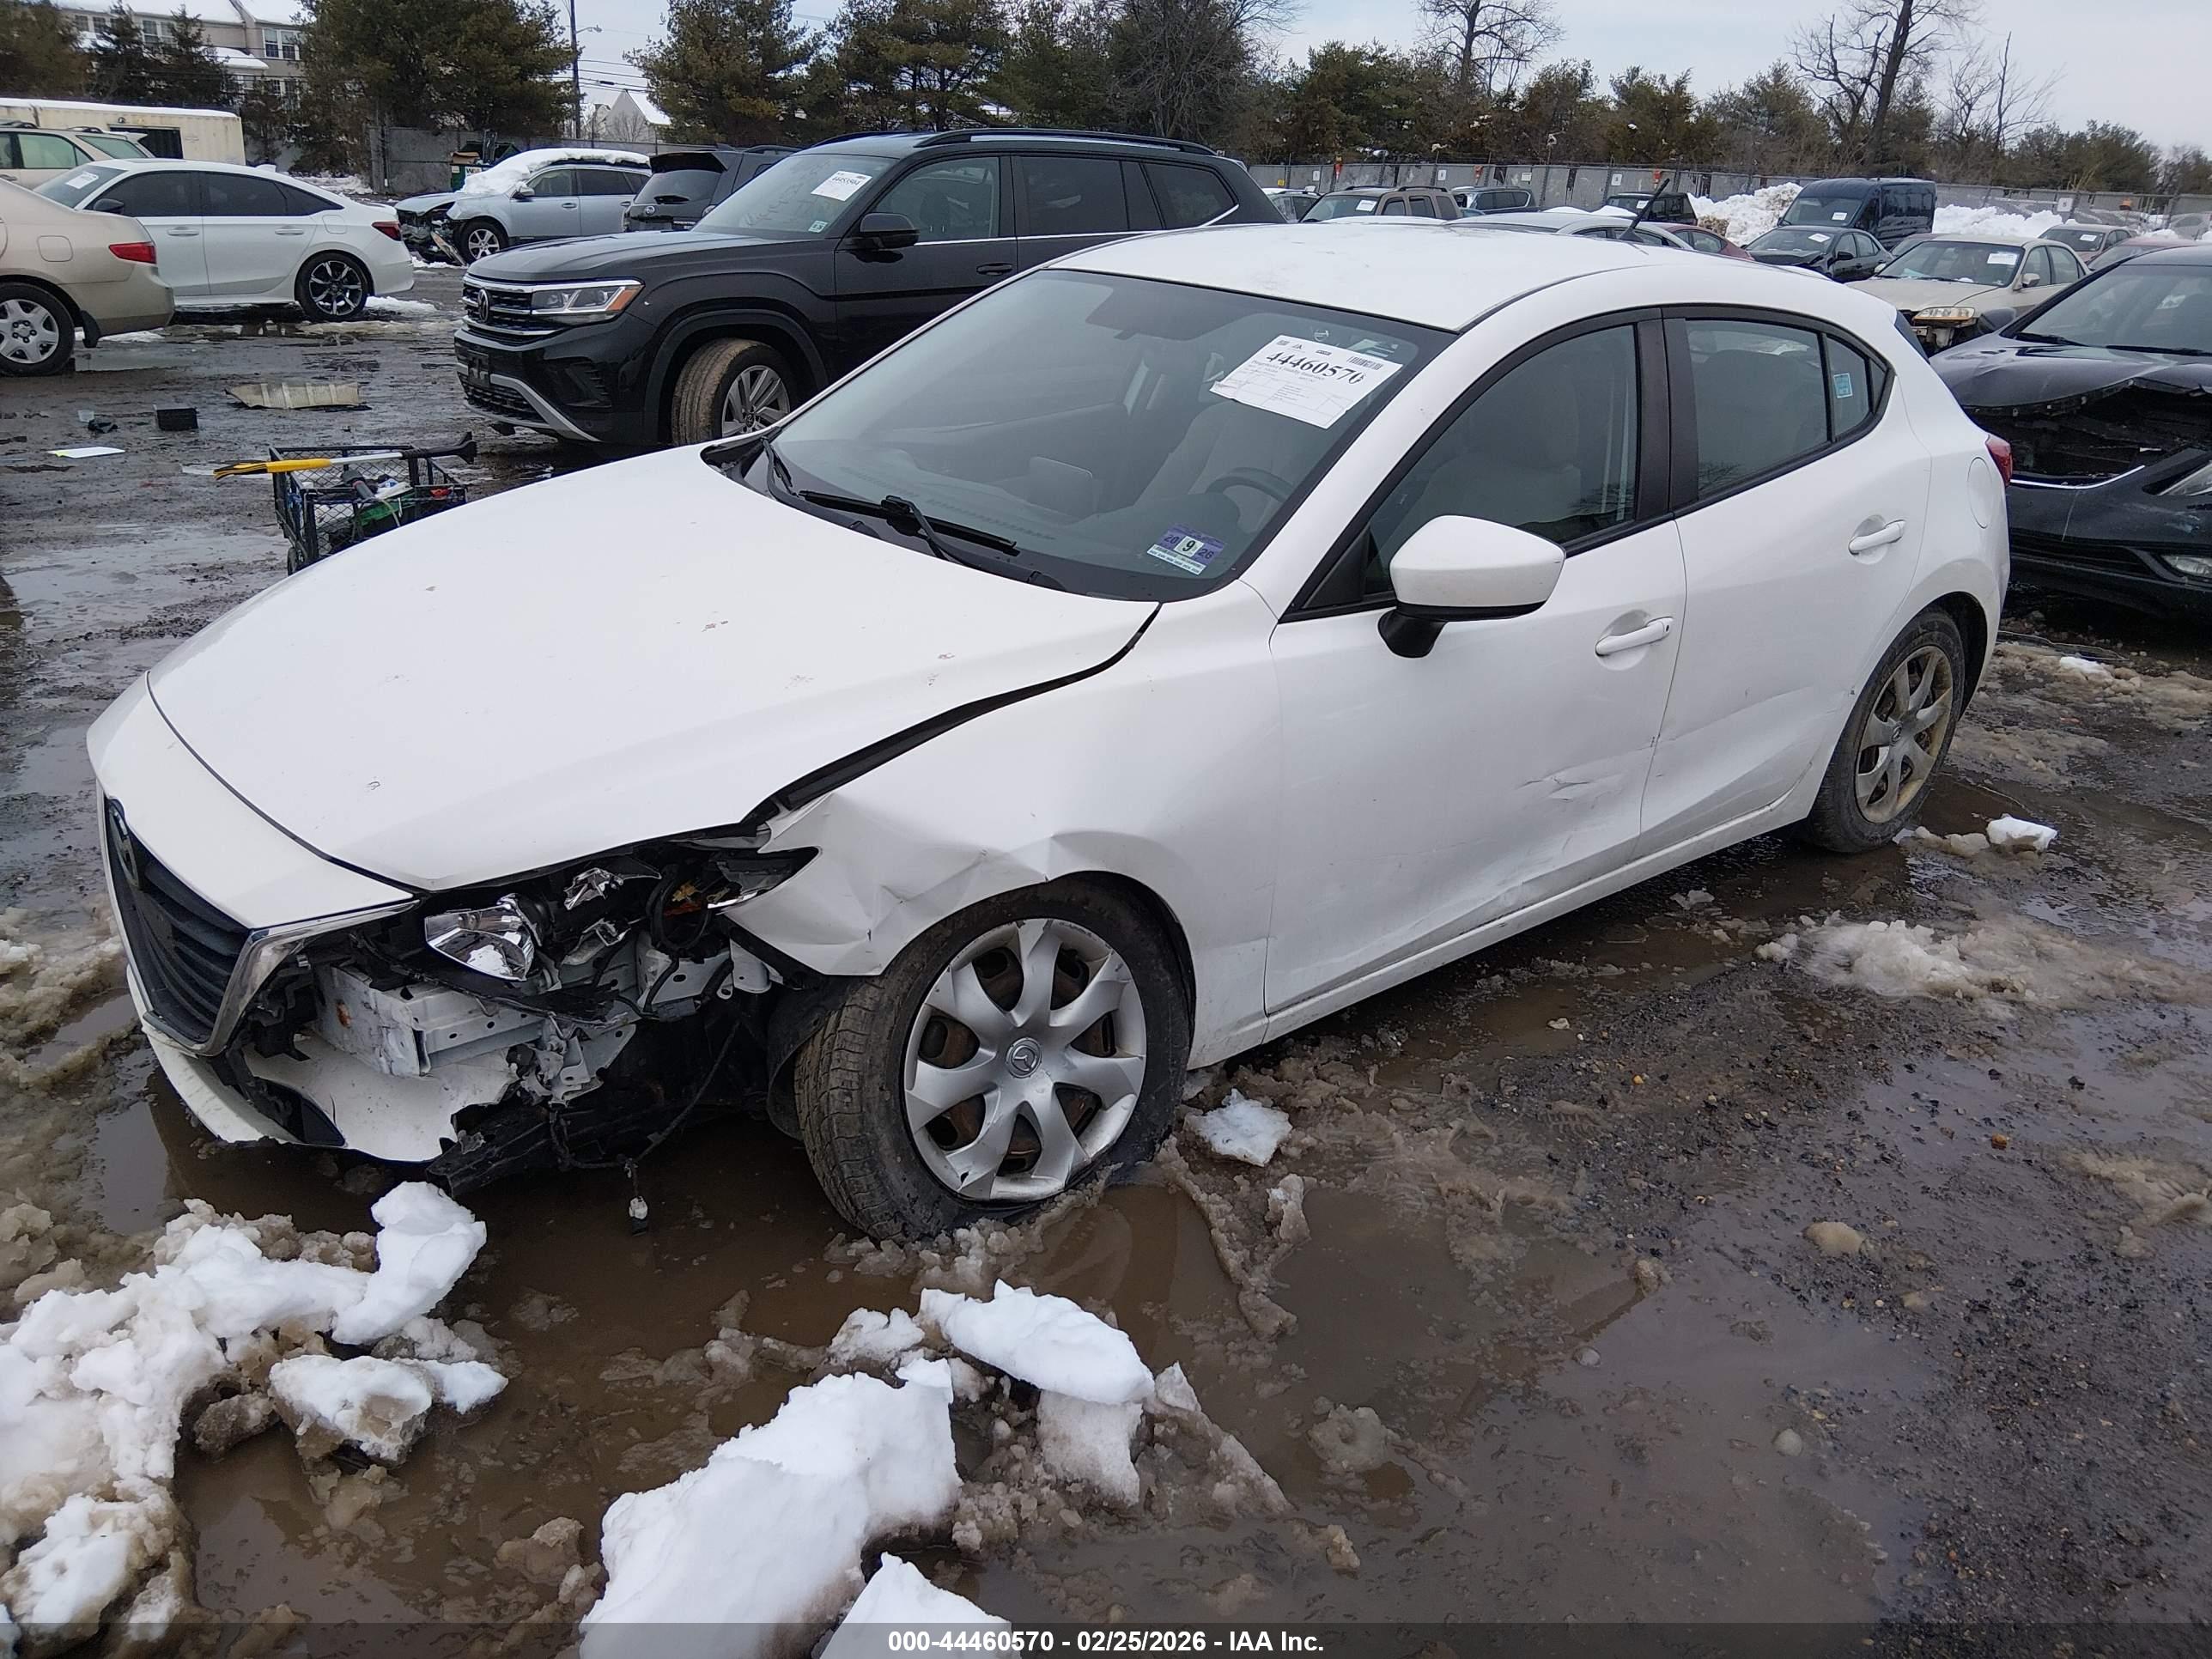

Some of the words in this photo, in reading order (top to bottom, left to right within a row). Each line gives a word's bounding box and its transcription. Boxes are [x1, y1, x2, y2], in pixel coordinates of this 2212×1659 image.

[1266, 351, 1364, 385] 44460570
[1164, 534, 1180, 544] 20
[1182, 539, 1196, 552] 9
[1198, 548, 1214, 559] 26
